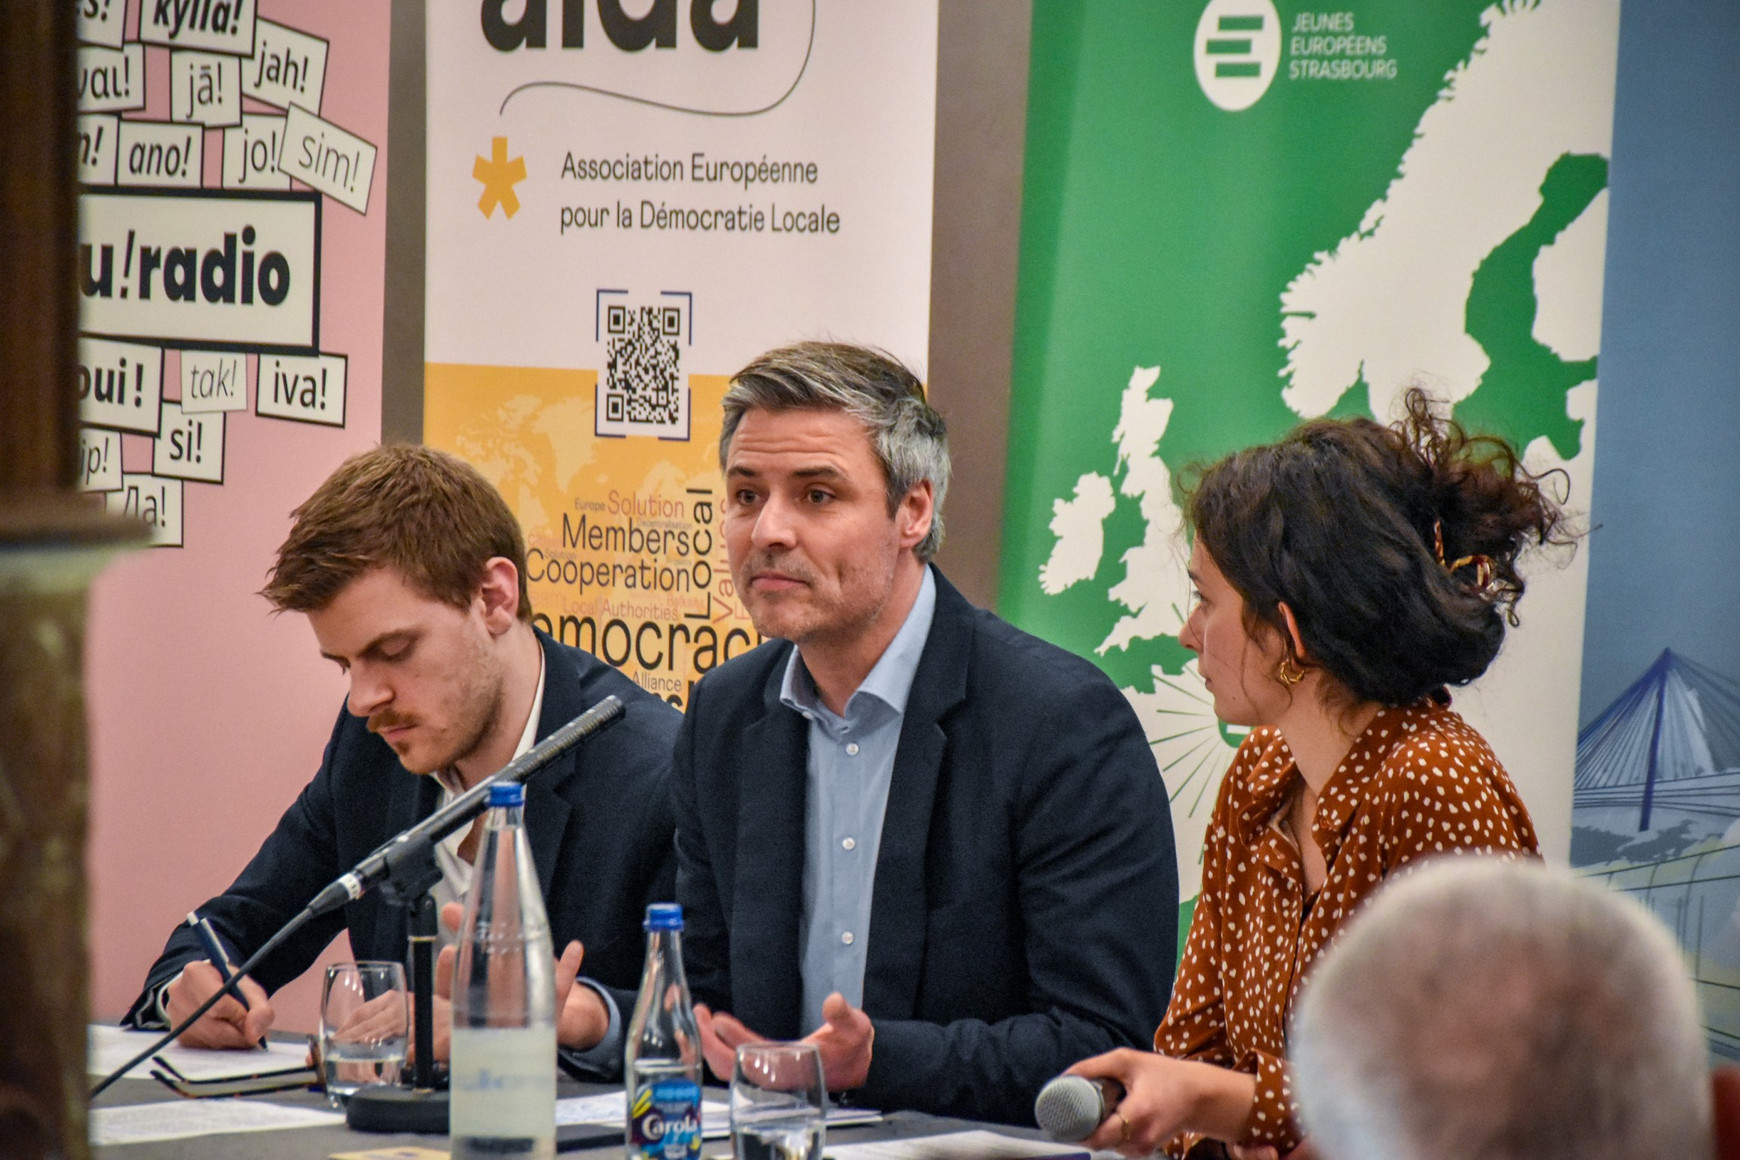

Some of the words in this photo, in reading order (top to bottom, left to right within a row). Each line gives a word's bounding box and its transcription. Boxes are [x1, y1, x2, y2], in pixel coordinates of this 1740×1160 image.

[1292, 12, 1354, 32] JEUNES
[254, 40, 308, 93] jah!
[1289, 59, 1398, 79] STRASBOURG
[186, 62, 222, 119] jā!
[129, 136, 191, 178] ano!
[238, 128, 276, 183] jo!
[298, 132, 360, 193] sim!
[561, 152, 684, 181] Association
[691, 153, 819, 190] Européenne
[561, 206, 610, 235] pour
[616, 201, 632, 228] la
[640, 201, 765, 232] Démocratie
[771, 203, 841, 234] Locale
[190, 358, 237, 400] tak!
[272, 360, 328, 411] iva!
[169, 419, 202, 464] si!
[608, 489, 685, 519] Solution
[562, 512, 690, 557] Members
[684, 488, 713, 620] Local
[526, 547, 690, 596] Cooperation
[602, 598, 680, 624] Authorities
[633, 670, 682, 693] Alliance
